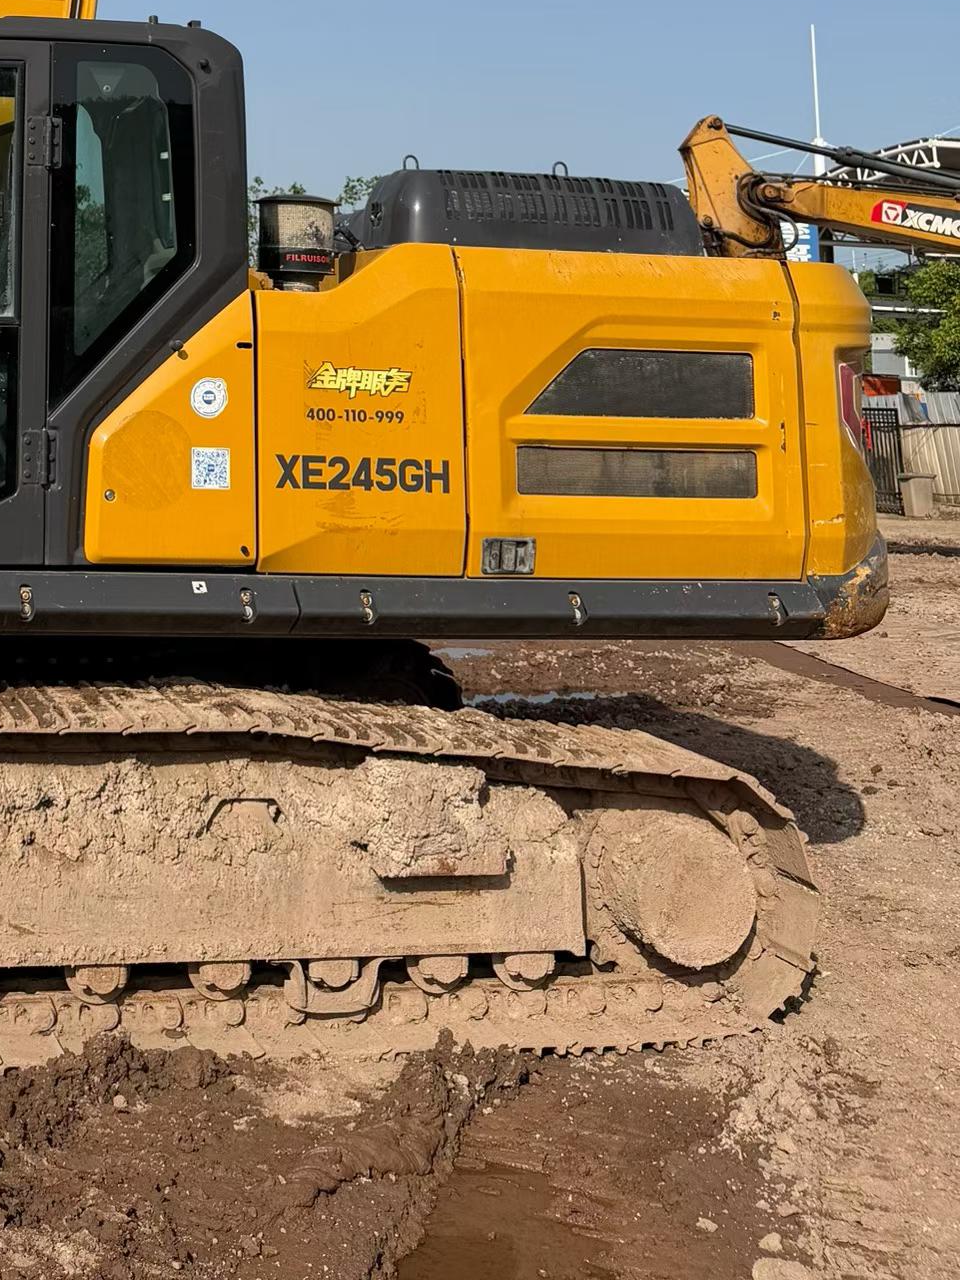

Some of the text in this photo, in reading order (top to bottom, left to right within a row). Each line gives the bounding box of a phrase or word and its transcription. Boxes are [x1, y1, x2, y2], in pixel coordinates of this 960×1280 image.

[307, 361, 413, 399] 金牌服务
[306, 408, 405, 423] 400-110-999
[275, 454, 450, 494] XE245GH
